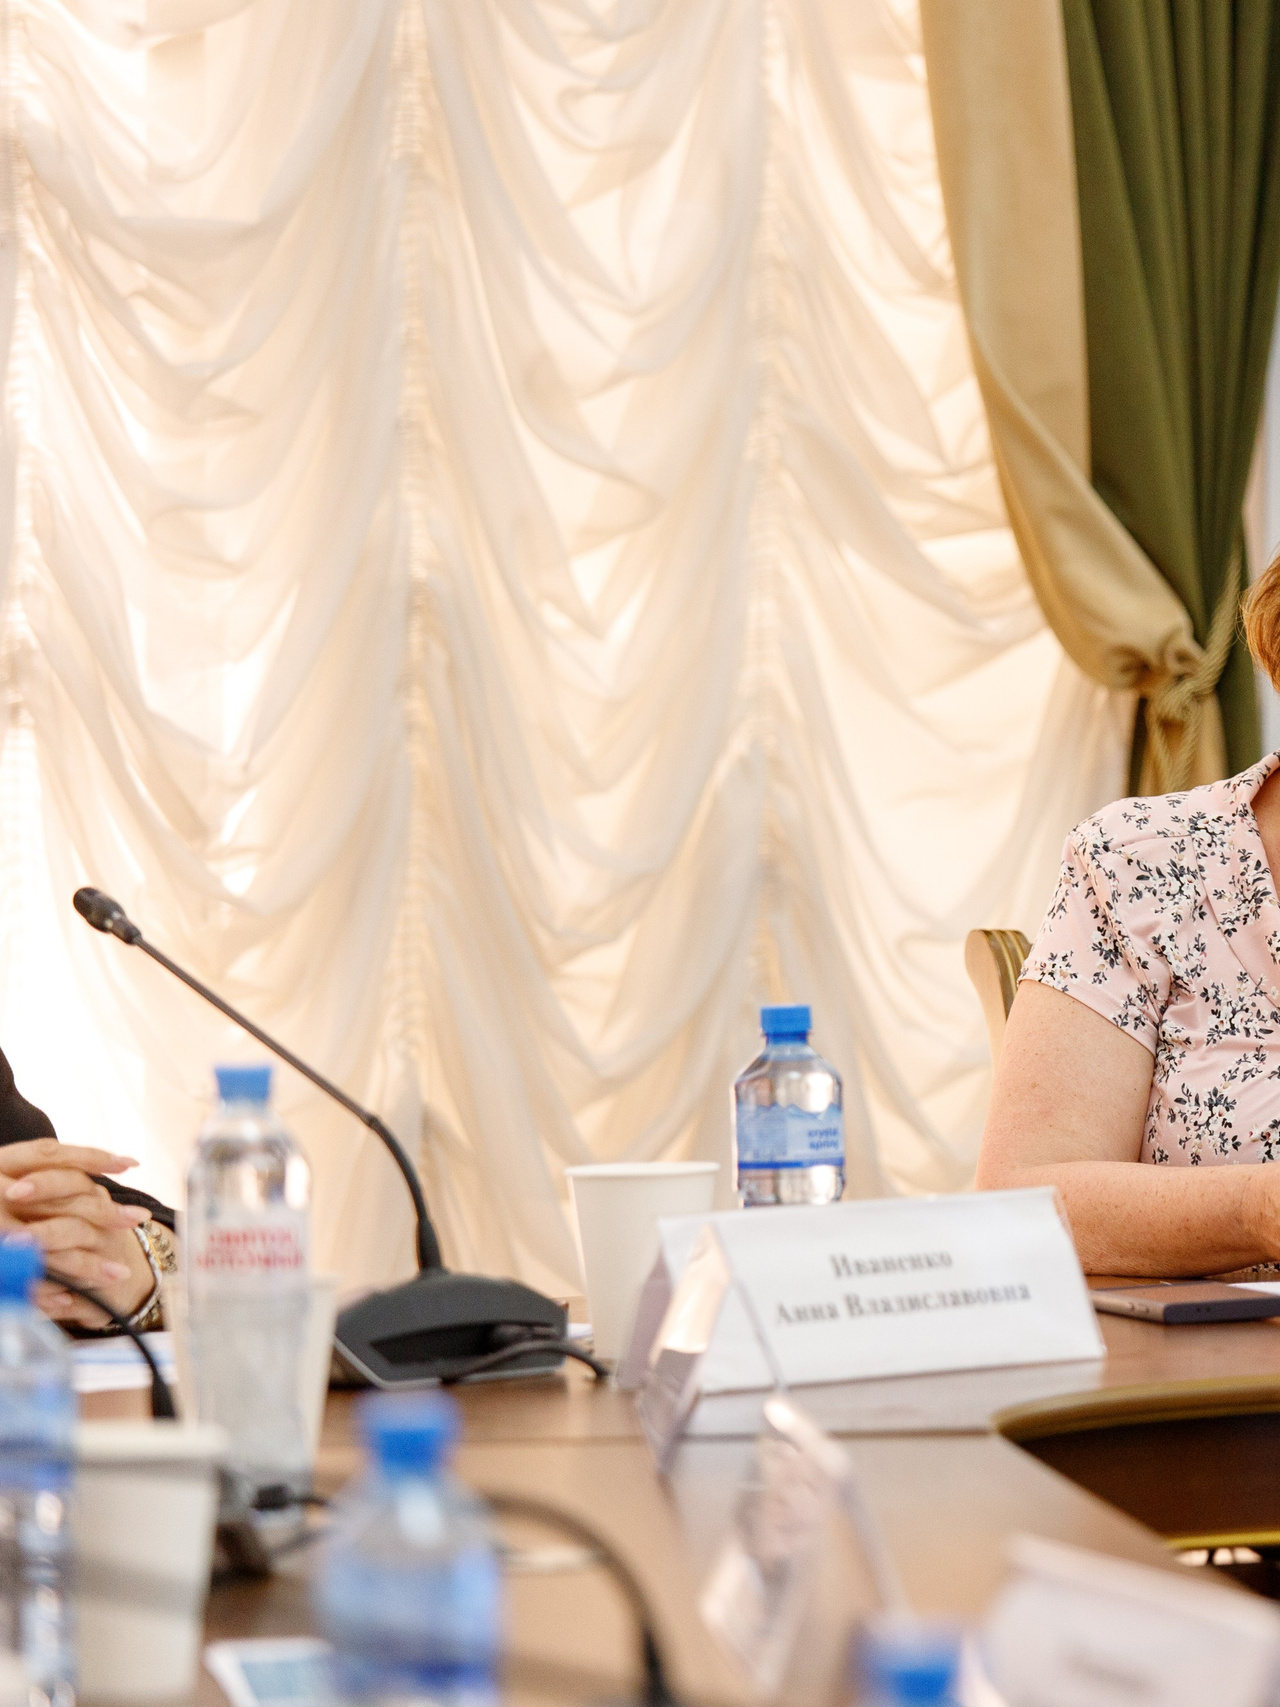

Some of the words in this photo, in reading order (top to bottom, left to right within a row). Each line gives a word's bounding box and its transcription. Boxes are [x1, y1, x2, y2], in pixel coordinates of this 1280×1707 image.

[830, 1251, 953, 1279] Иваненко
[777, 1302, 839, 1325] Анна
[844, 1283, 1032, 1318] Владиславовна
